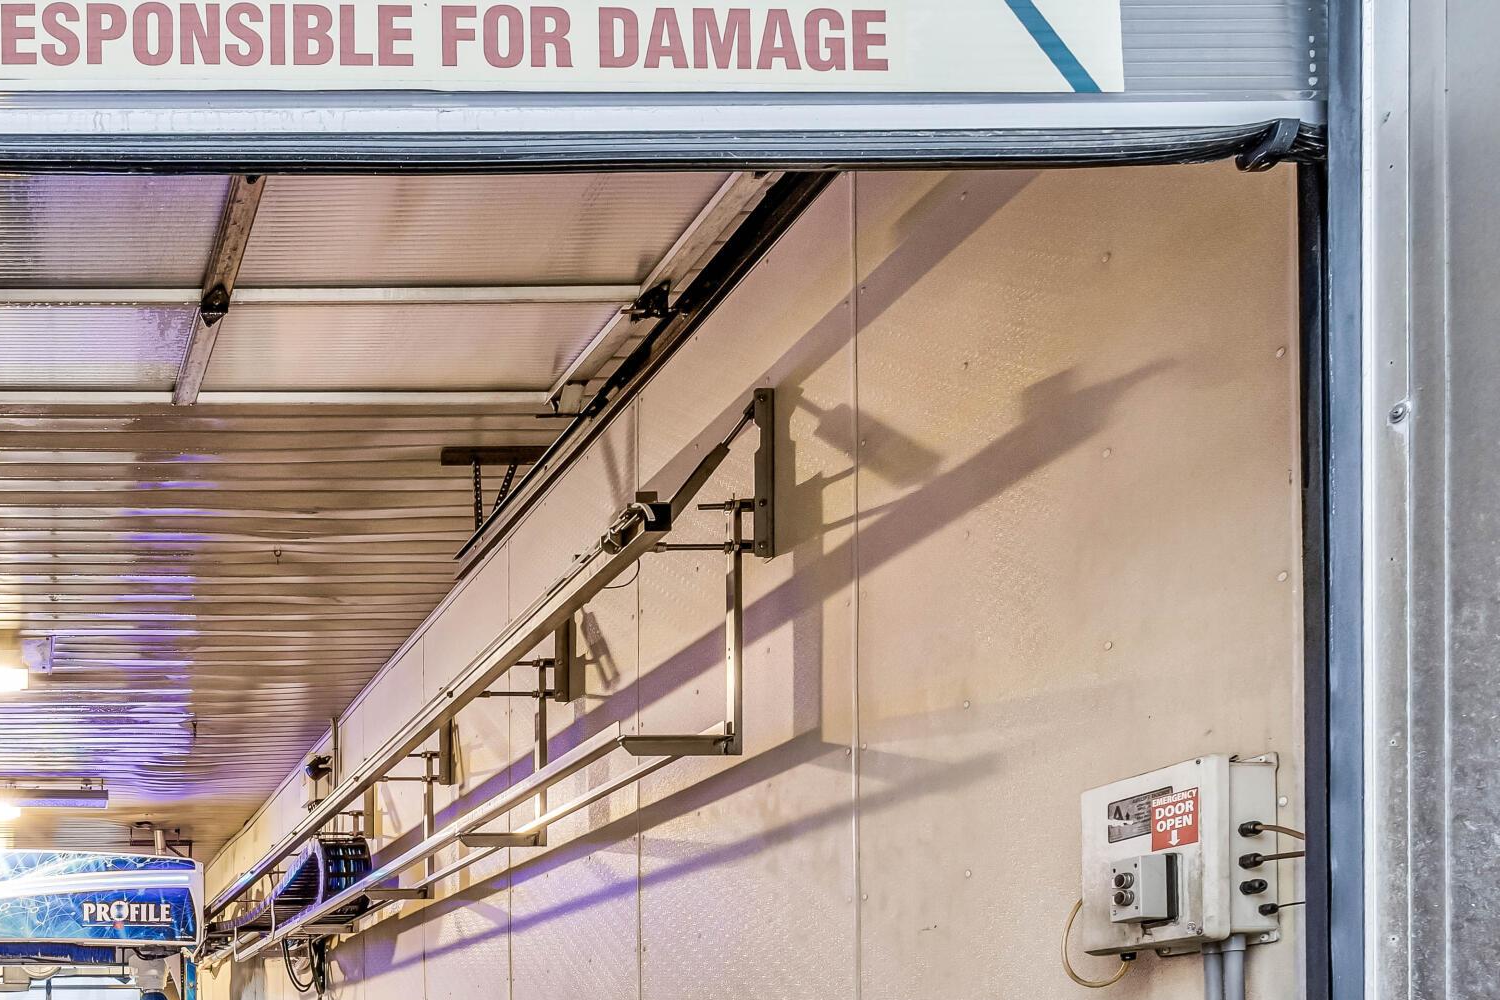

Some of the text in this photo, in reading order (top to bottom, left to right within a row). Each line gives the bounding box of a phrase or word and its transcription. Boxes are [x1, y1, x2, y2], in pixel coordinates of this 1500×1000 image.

[442, 4, 570, 68] FOR
[599, 6, 887, 71] DAMAGE
[1152, 789, 1197, 807] EMERGENCY
[1155, 800, 1194, 820] DOOR
[1156, 813, 1193, 832] OPEN
[82, 900, 173, 922] PROFILE
